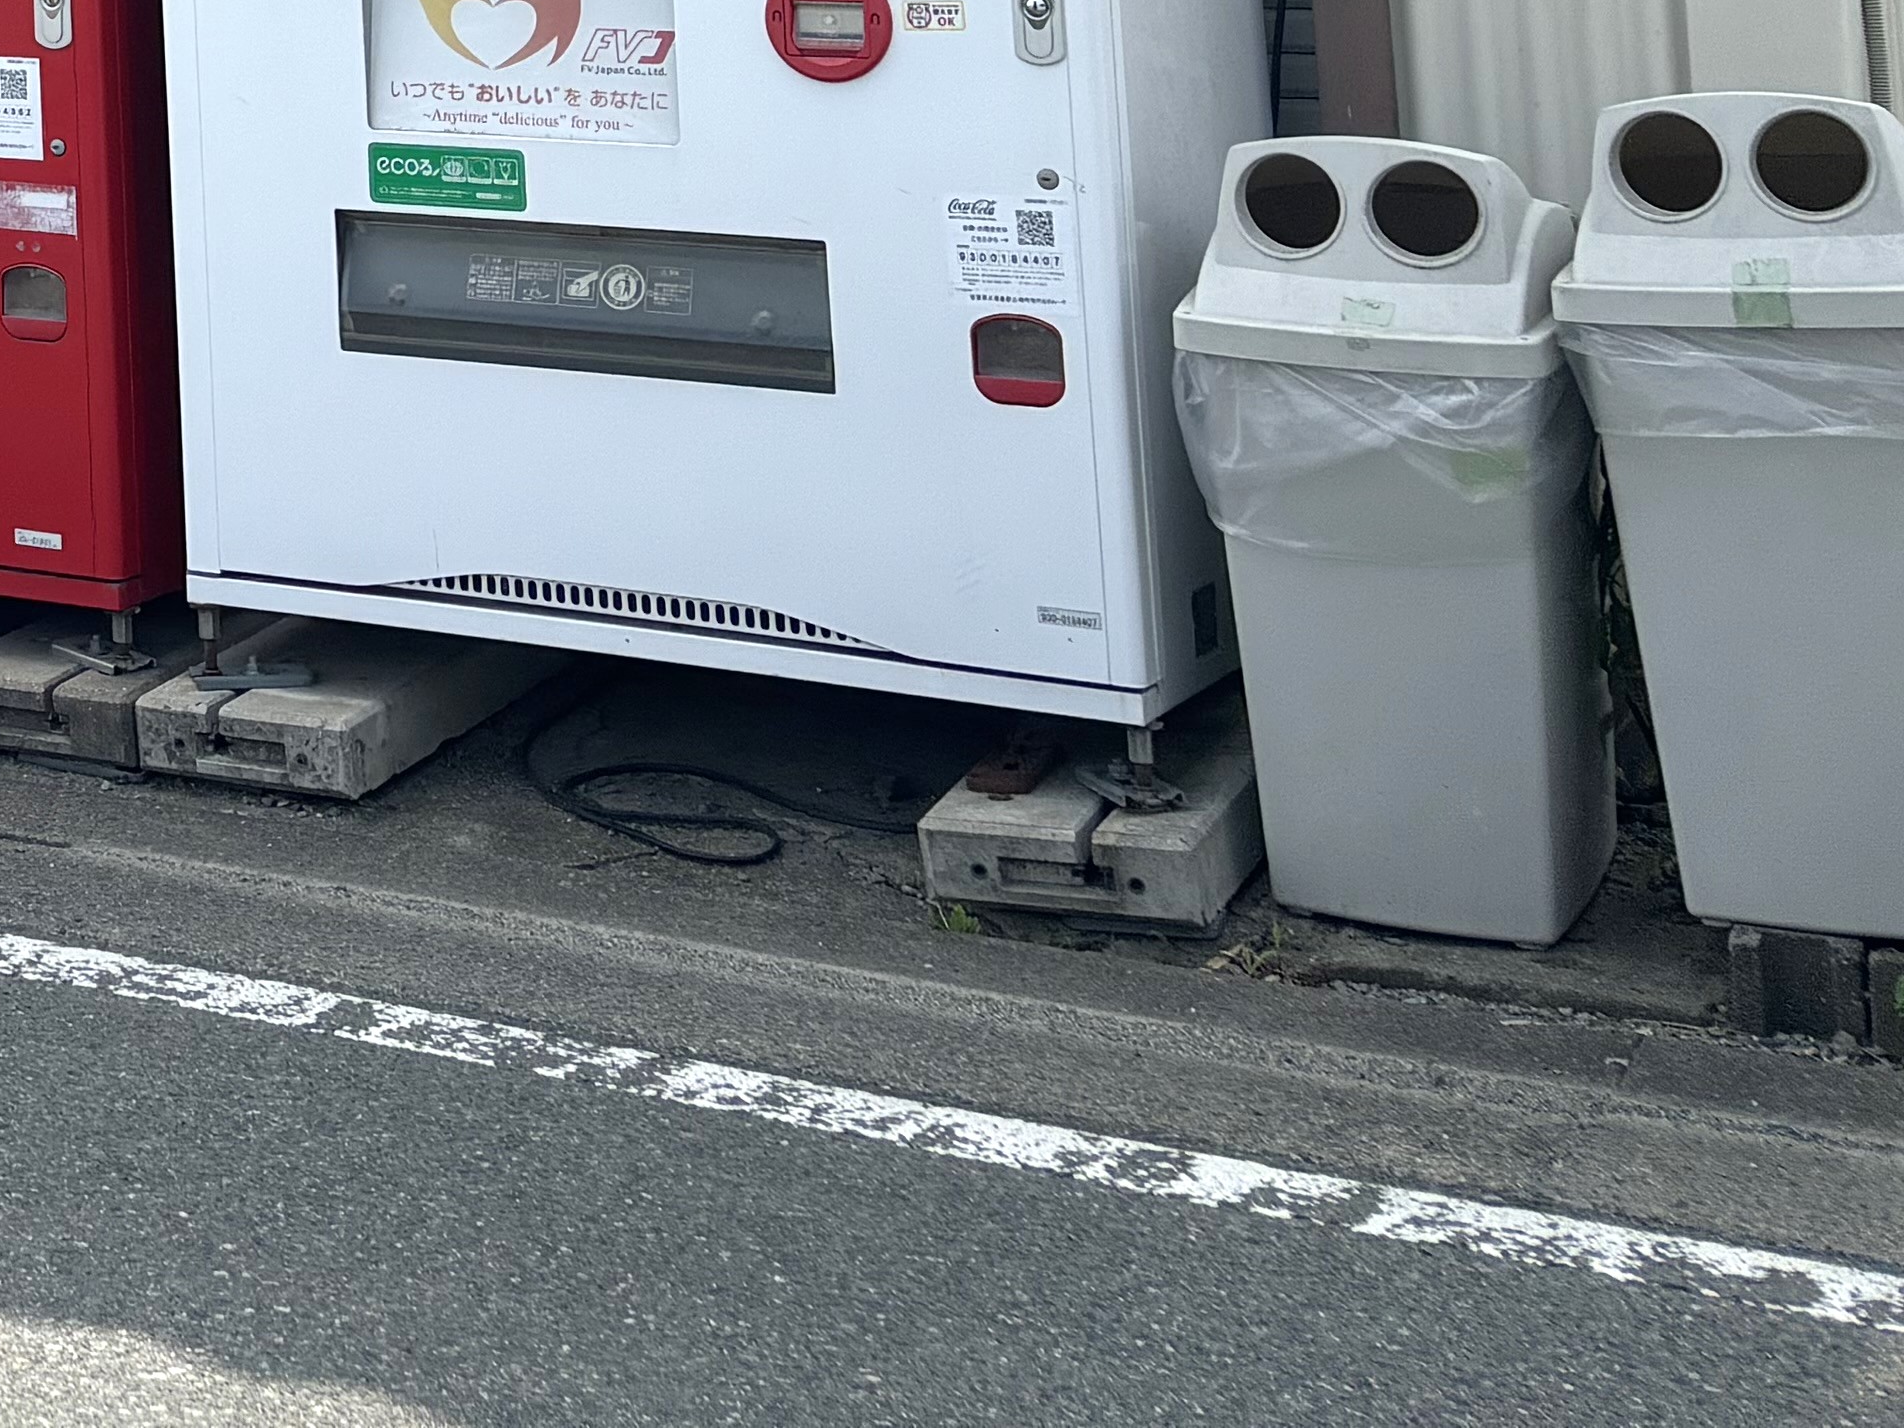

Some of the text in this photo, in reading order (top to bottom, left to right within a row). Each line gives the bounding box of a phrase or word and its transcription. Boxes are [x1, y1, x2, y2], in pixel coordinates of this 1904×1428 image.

[937, 16, 956, 27] OK
[594, 66, 626, 76] Japan
[589, 90, 669, 111] あなたに
[571, 115, 591, 130] for
[594, 119, 621, 133] you
